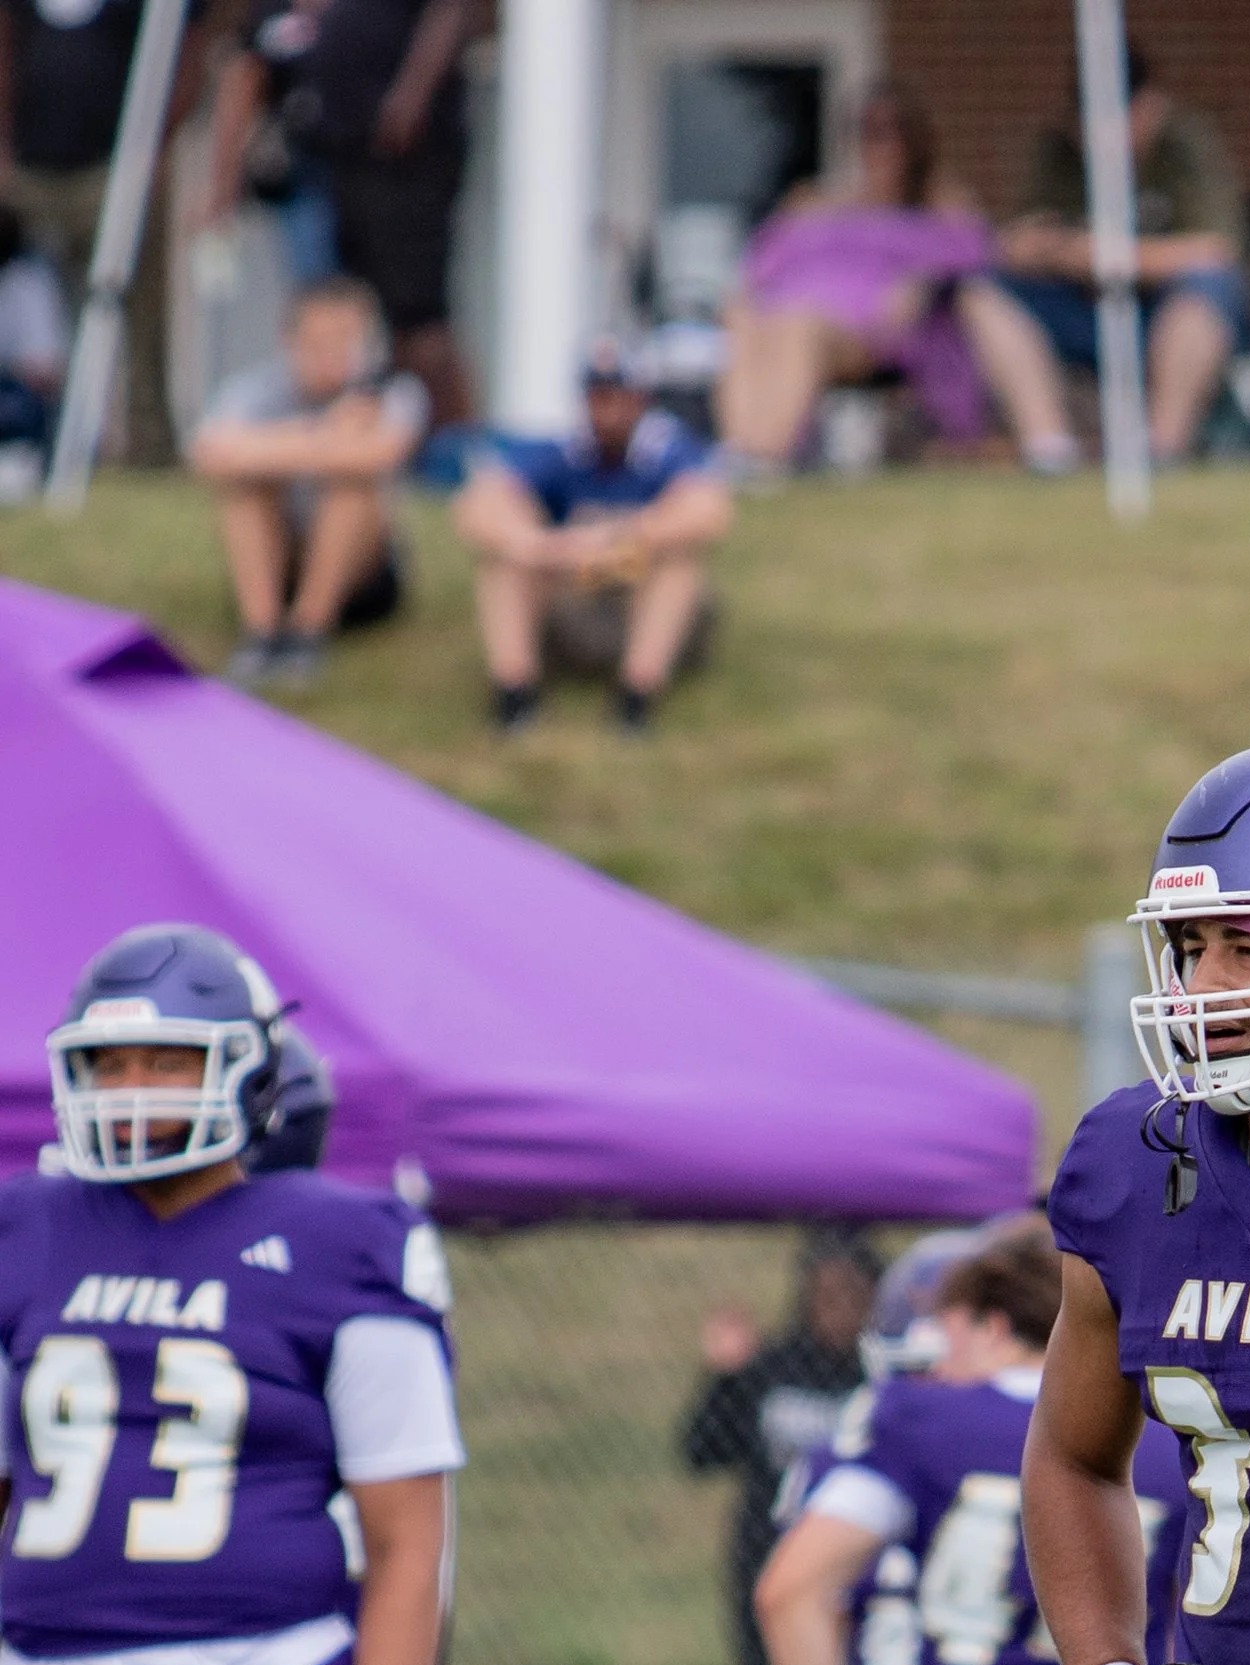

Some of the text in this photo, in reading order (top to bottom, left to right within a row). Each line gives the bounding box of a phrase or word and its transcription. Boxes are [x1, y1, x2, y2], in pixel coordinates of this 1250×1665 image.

[1155, 871, 1204, 890] Riddell
[61, 1273, 227, 1331] AVILA
[11, 1335, 249, 1562] 93
